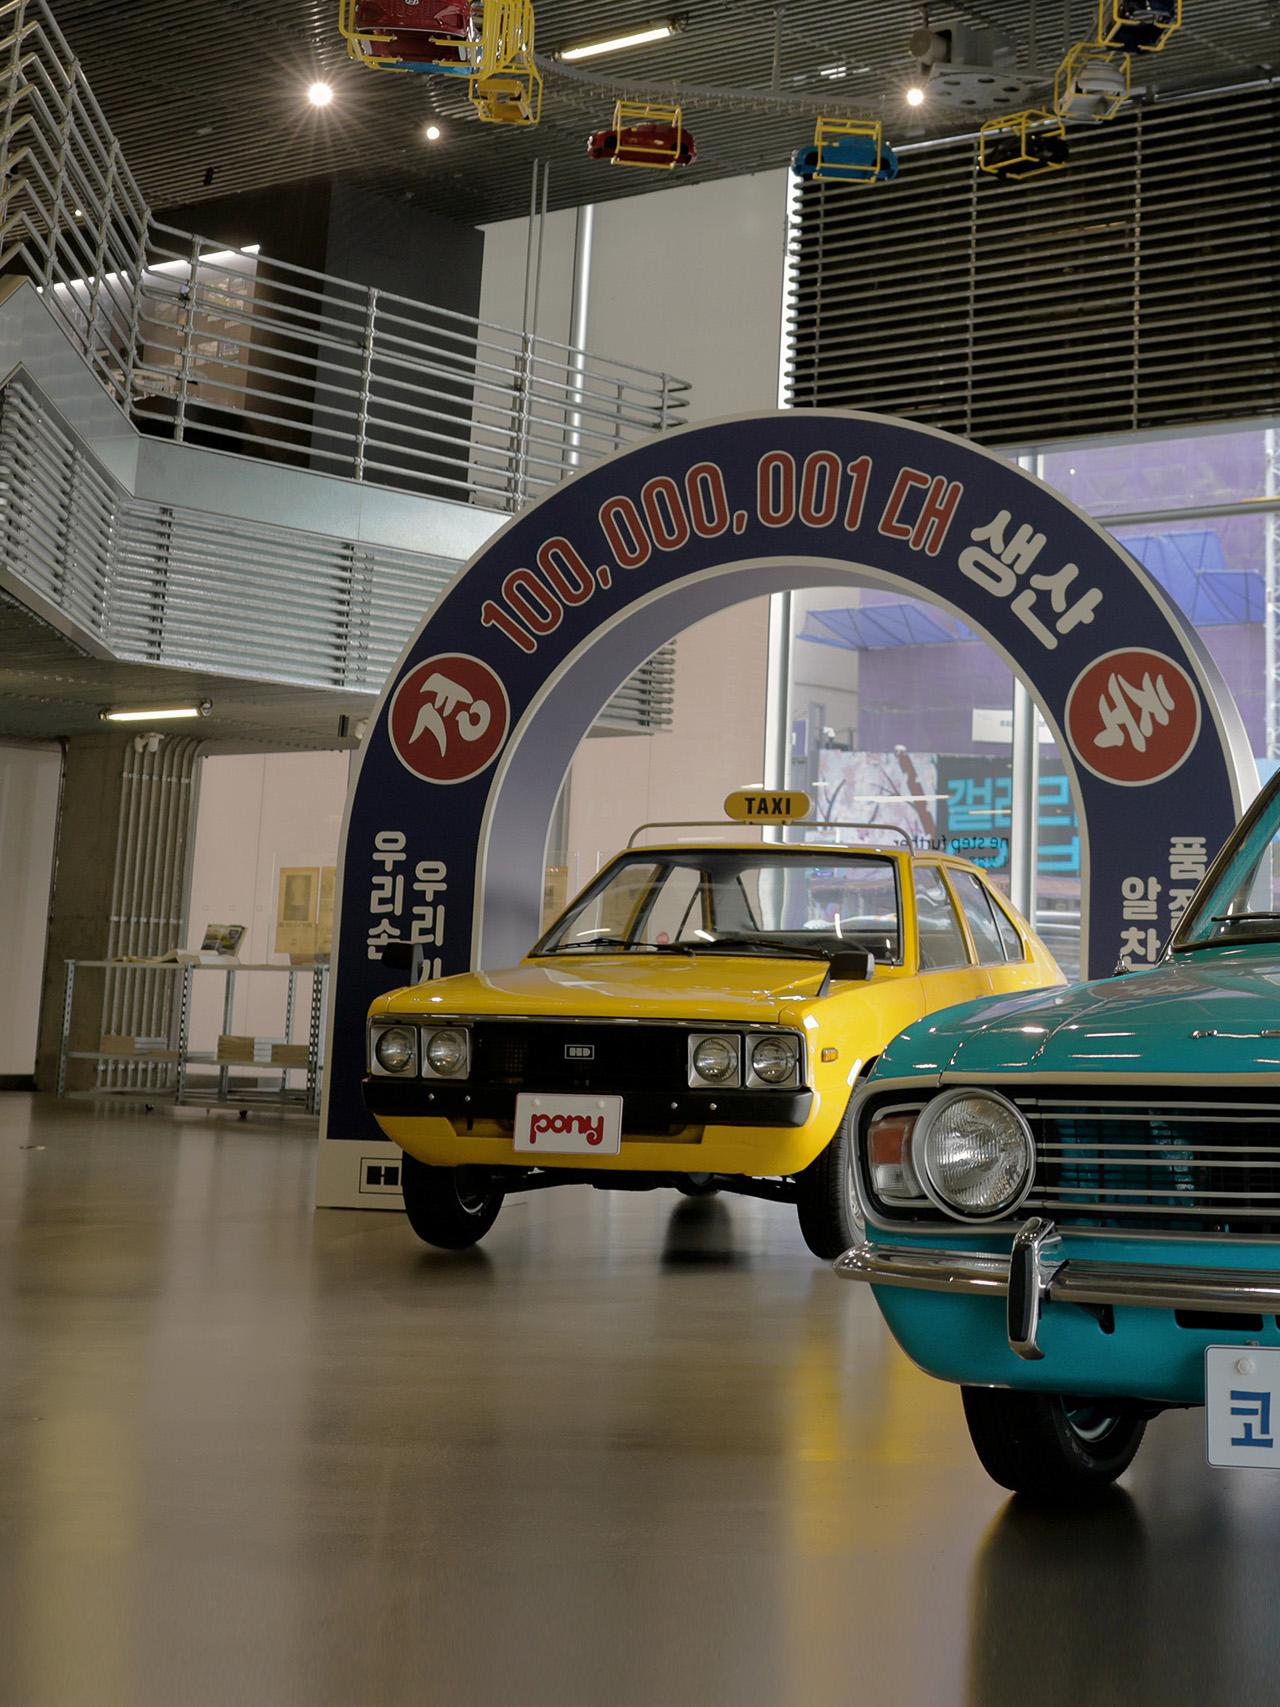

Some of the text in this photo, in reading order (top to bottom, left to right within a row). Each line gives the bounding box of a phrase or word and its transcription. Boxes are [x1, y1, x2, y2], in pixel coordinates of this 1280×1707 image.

[481, 450, 1103, 654] 100,000,001 대 생산
[744, 797, 791, 815] TAXI
[1120, 876, 1162, 972] 알찬
[529, 1113, 605, 1146] pony
